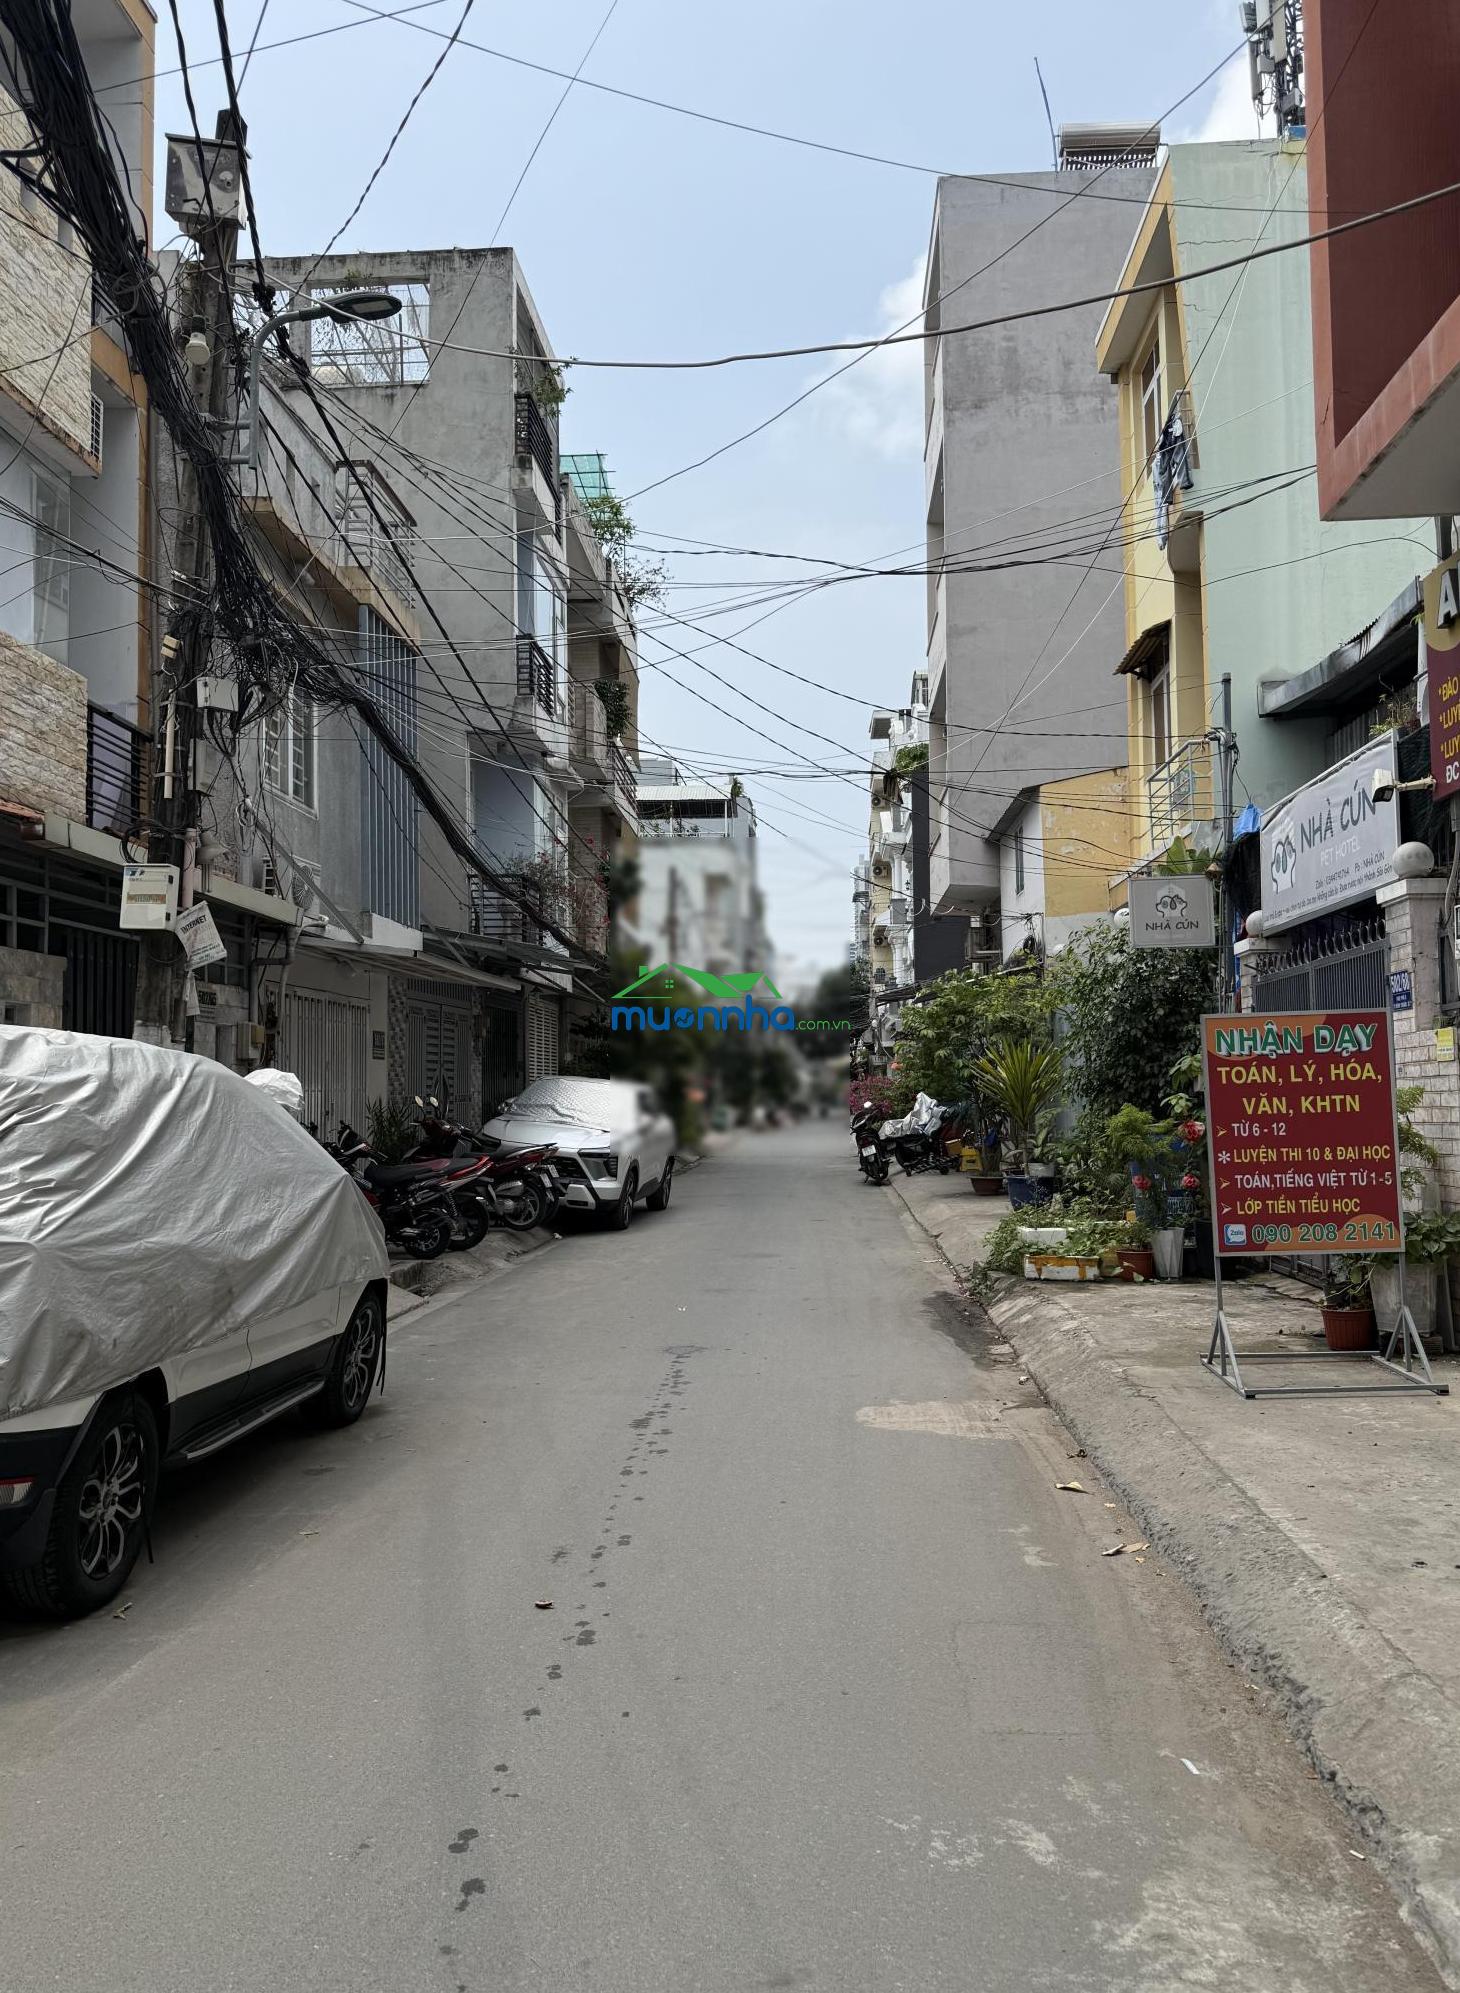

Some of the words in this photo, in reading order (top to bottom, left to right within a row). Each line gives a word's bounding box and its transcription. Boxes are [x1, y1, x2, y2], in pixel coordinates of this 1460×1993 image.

[1438, 569, 1460, 626] A
[1446, 761, 1459, 783] ĐC
[1300, 797, 1334, 853] NHÀ
[1340, 779, 1376, 831] CÚN
[1320, 847, 1333, 866] PET
[1336, 836, 1360, 860] HOTEL
[1175, 918, 1199, 930] CÚN
[1215, 1020, 1303, 1059] NHẬN
[1313, 1023, 1378, 1057] DẠY
[1217, 1061, 1283, 1086] TOÁN,
[1290, 1059, 1323, 1085] LÝ,
[1330, 1058, 1382, 1083] HÓA,
[1242, 1092, 1294, 1117] VĂN,
[1301, 1094, 1360, 1114] KHTN
[1231, 1119, 1250, 1137] TỪ
[1252, 1123, 1260, 1136] 6
[1271, 1122, 1287, 1136] 12
[1233, 1144, 1277, 1165] LUYỆN
[1280, 1147, 1302, 1162] THI
[1306, 1147, 1320, 1161] 10
[1324, 1146, 1333, 1161] &
[1336, 1146, 1359, 1163] ĐẠI
[1362, 1144, 1391, 1163] HỌC
[1317, 1168, 1347, 1189] VIỆT
[1350, 1167, 1368, 1186] TỪ
[1236, 1197, 1262, 1215] LỚP
[1299, 1191, 1329, 1214] TIỂU
[1332, 1198, 1361, 1215] HỌC
[1252, 1224, 1292, 1244] 090
[1298, 1223, 1338, 1242] 208
[1345, 1222, 1395, 1242] 2141
